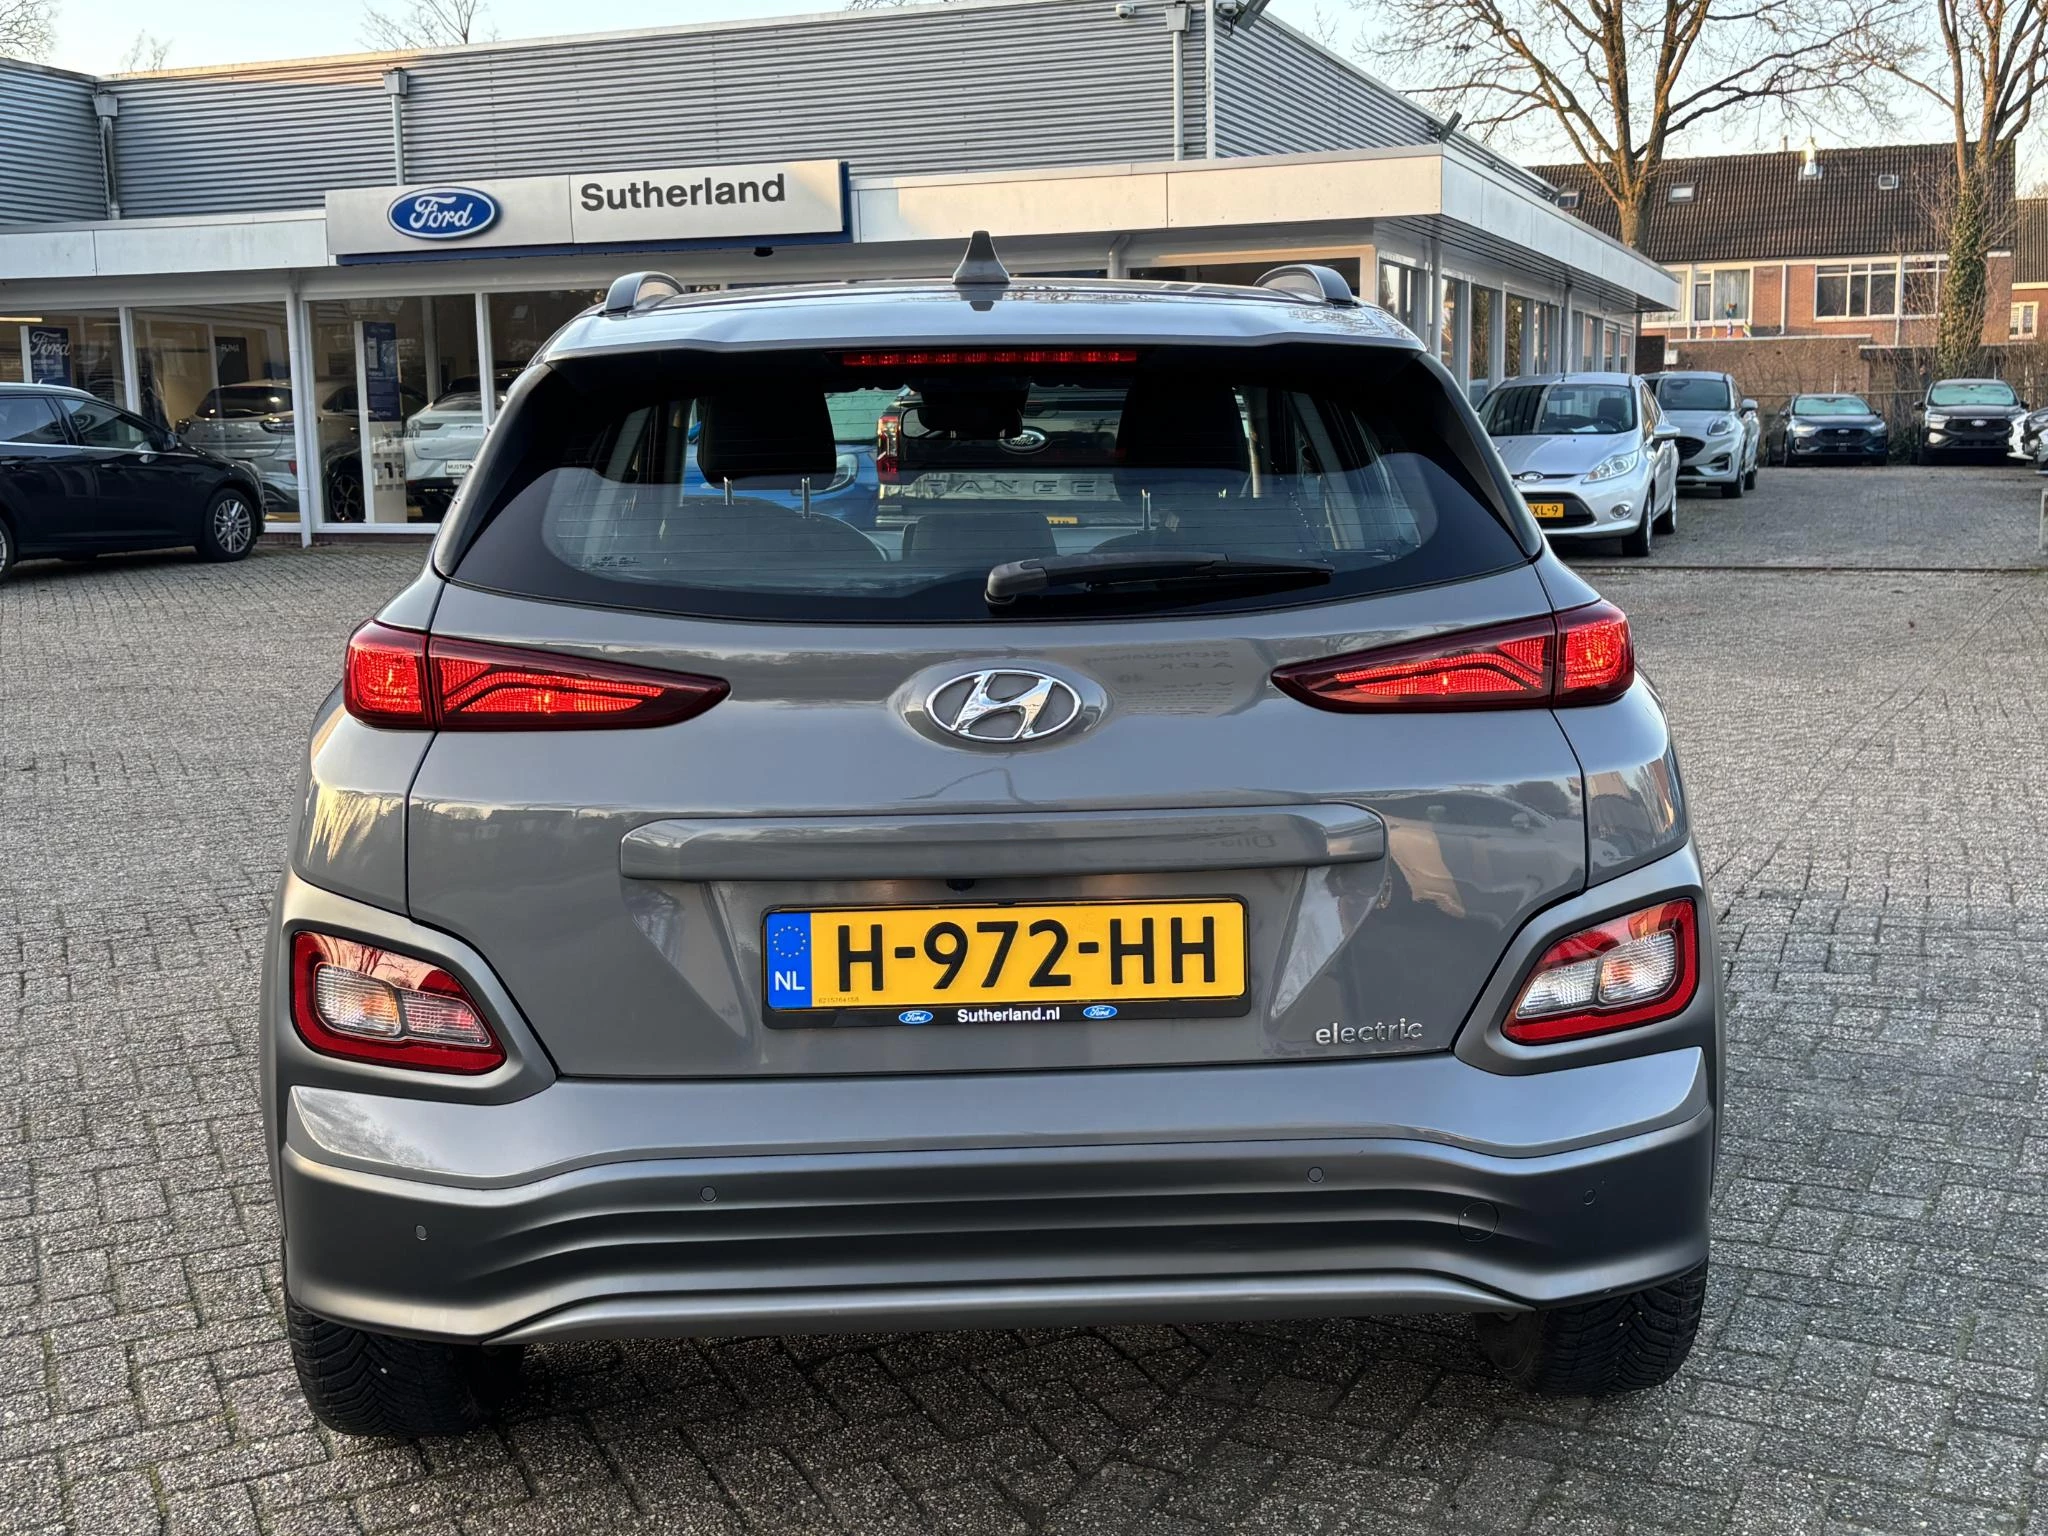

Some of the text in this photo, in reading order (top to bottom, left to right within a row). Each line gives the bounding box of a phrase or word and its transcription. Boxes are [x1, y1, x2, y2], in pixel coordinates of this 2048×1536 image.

[580, 173, 786, 212] Sutherland
[409, 196, 474, 229] Ford
[31, 331, 71, 356] Ford
[923, 479, 1114, 496] RANGE
[1532, 505, 1559, 515] XL-9
[837, 916, 1216, 993] H-972-HH
[774, 970, 806, 991] NL
[957, 1006, 1060, 1023] Sutherland.nl
[1315, 1018, 1423, 1044] electric
